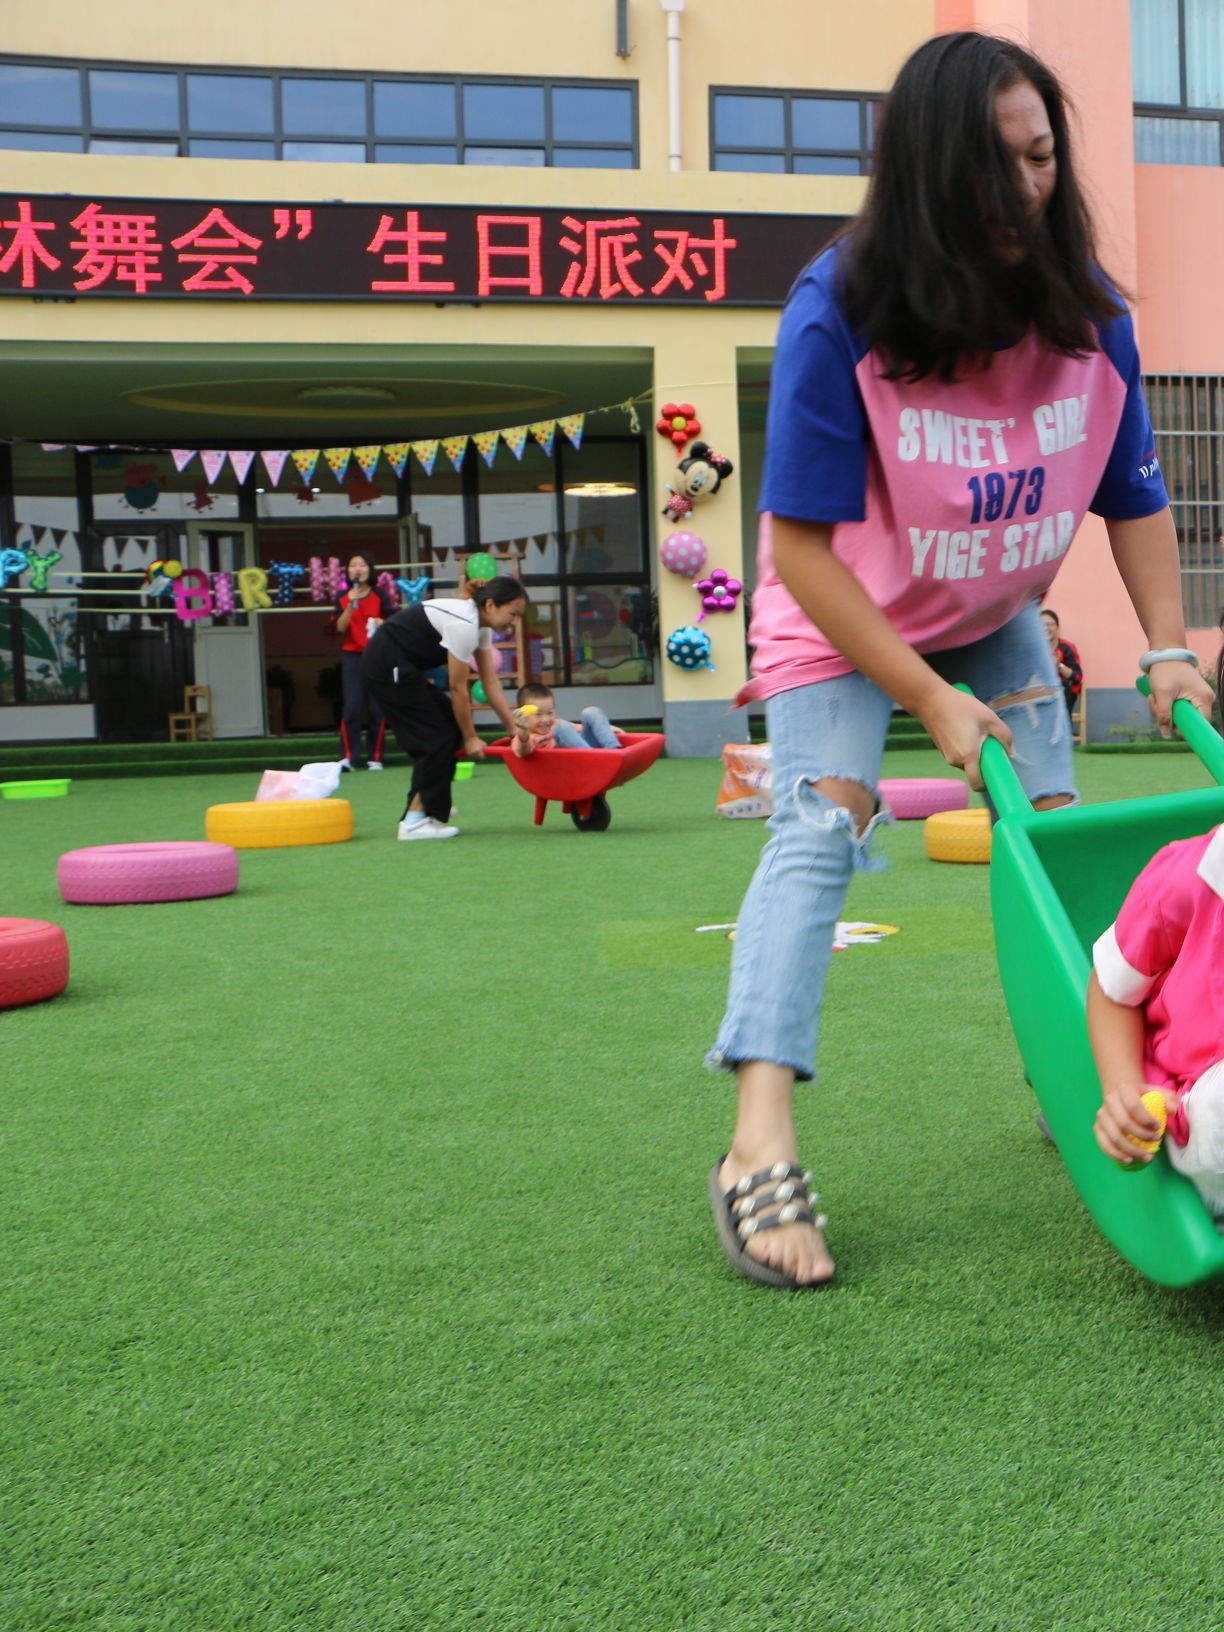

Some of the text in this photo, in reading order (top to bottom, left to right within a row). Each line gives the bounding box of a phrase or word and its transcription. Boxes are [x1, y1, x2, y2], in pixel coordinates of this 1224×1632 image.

[967, 466, 1045, 524] 1873
[908, 510, 1075, 580] YIGE STAR
